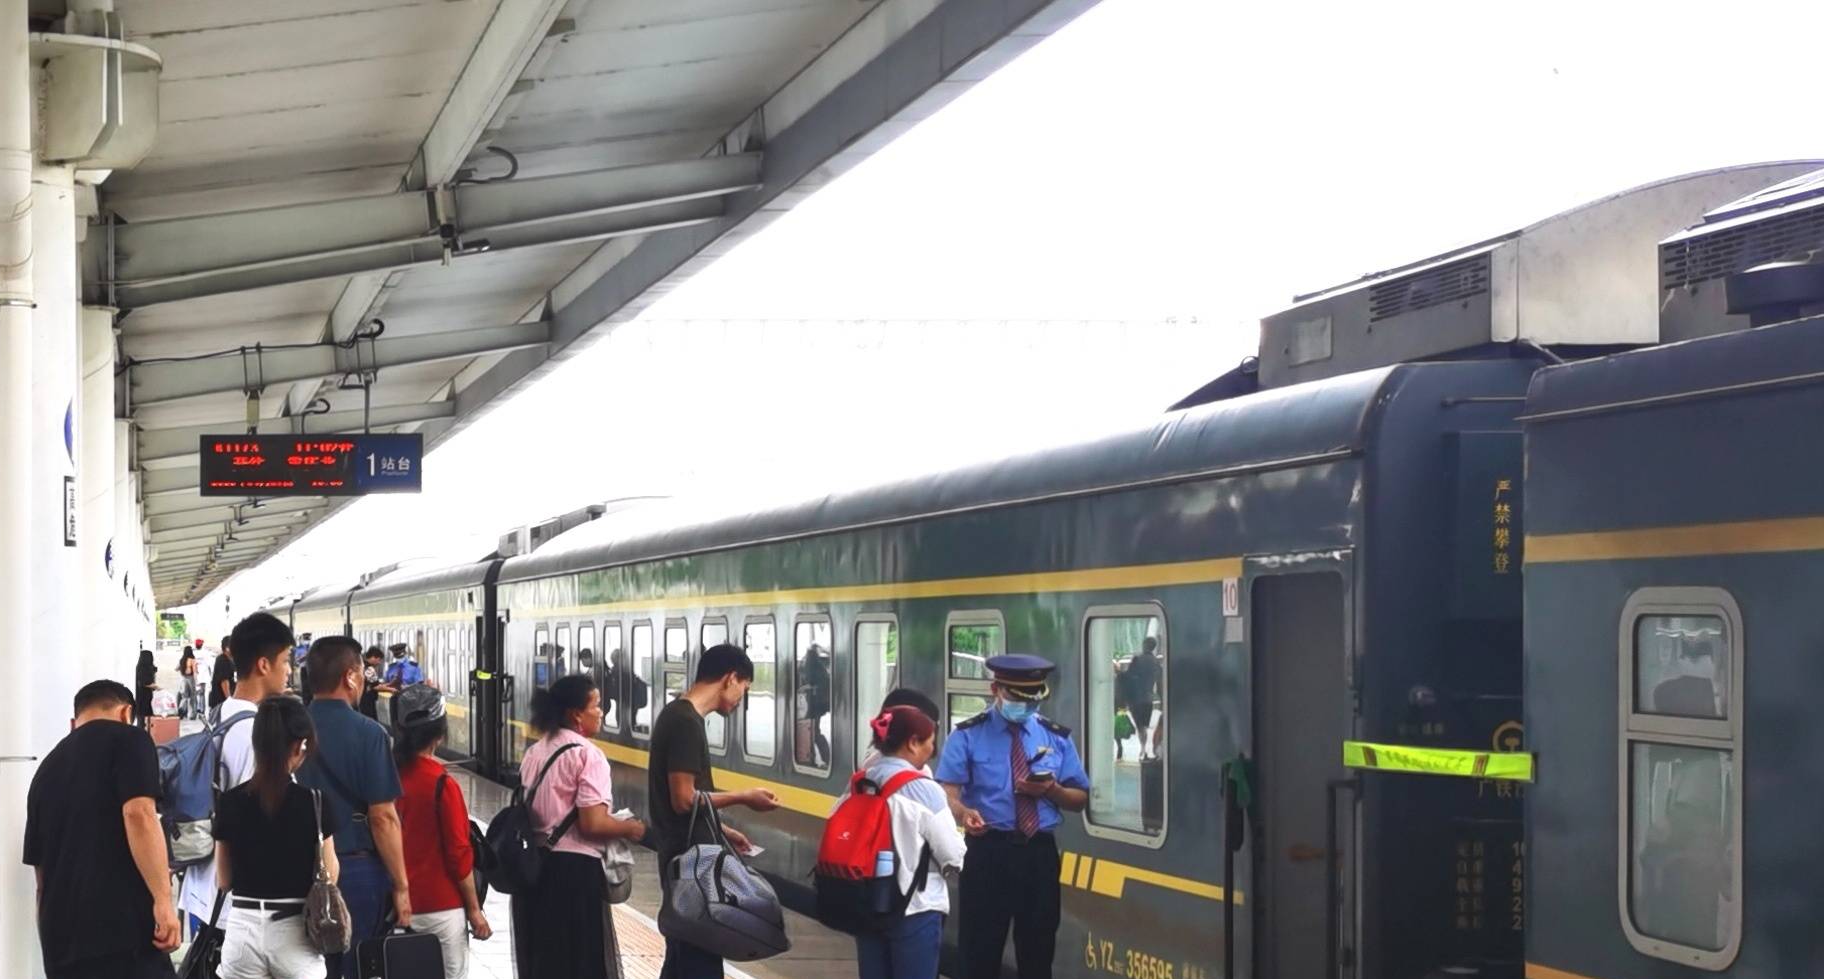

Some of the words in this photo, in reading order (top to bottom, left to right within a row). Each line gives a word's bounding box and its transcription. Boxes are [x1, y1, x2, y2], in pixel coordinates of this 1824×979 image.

[366, 452, 376, 477] 1
[380, 456, 411, 471] 站台
[1494, 479, 1512, 574] 严禁攀登
